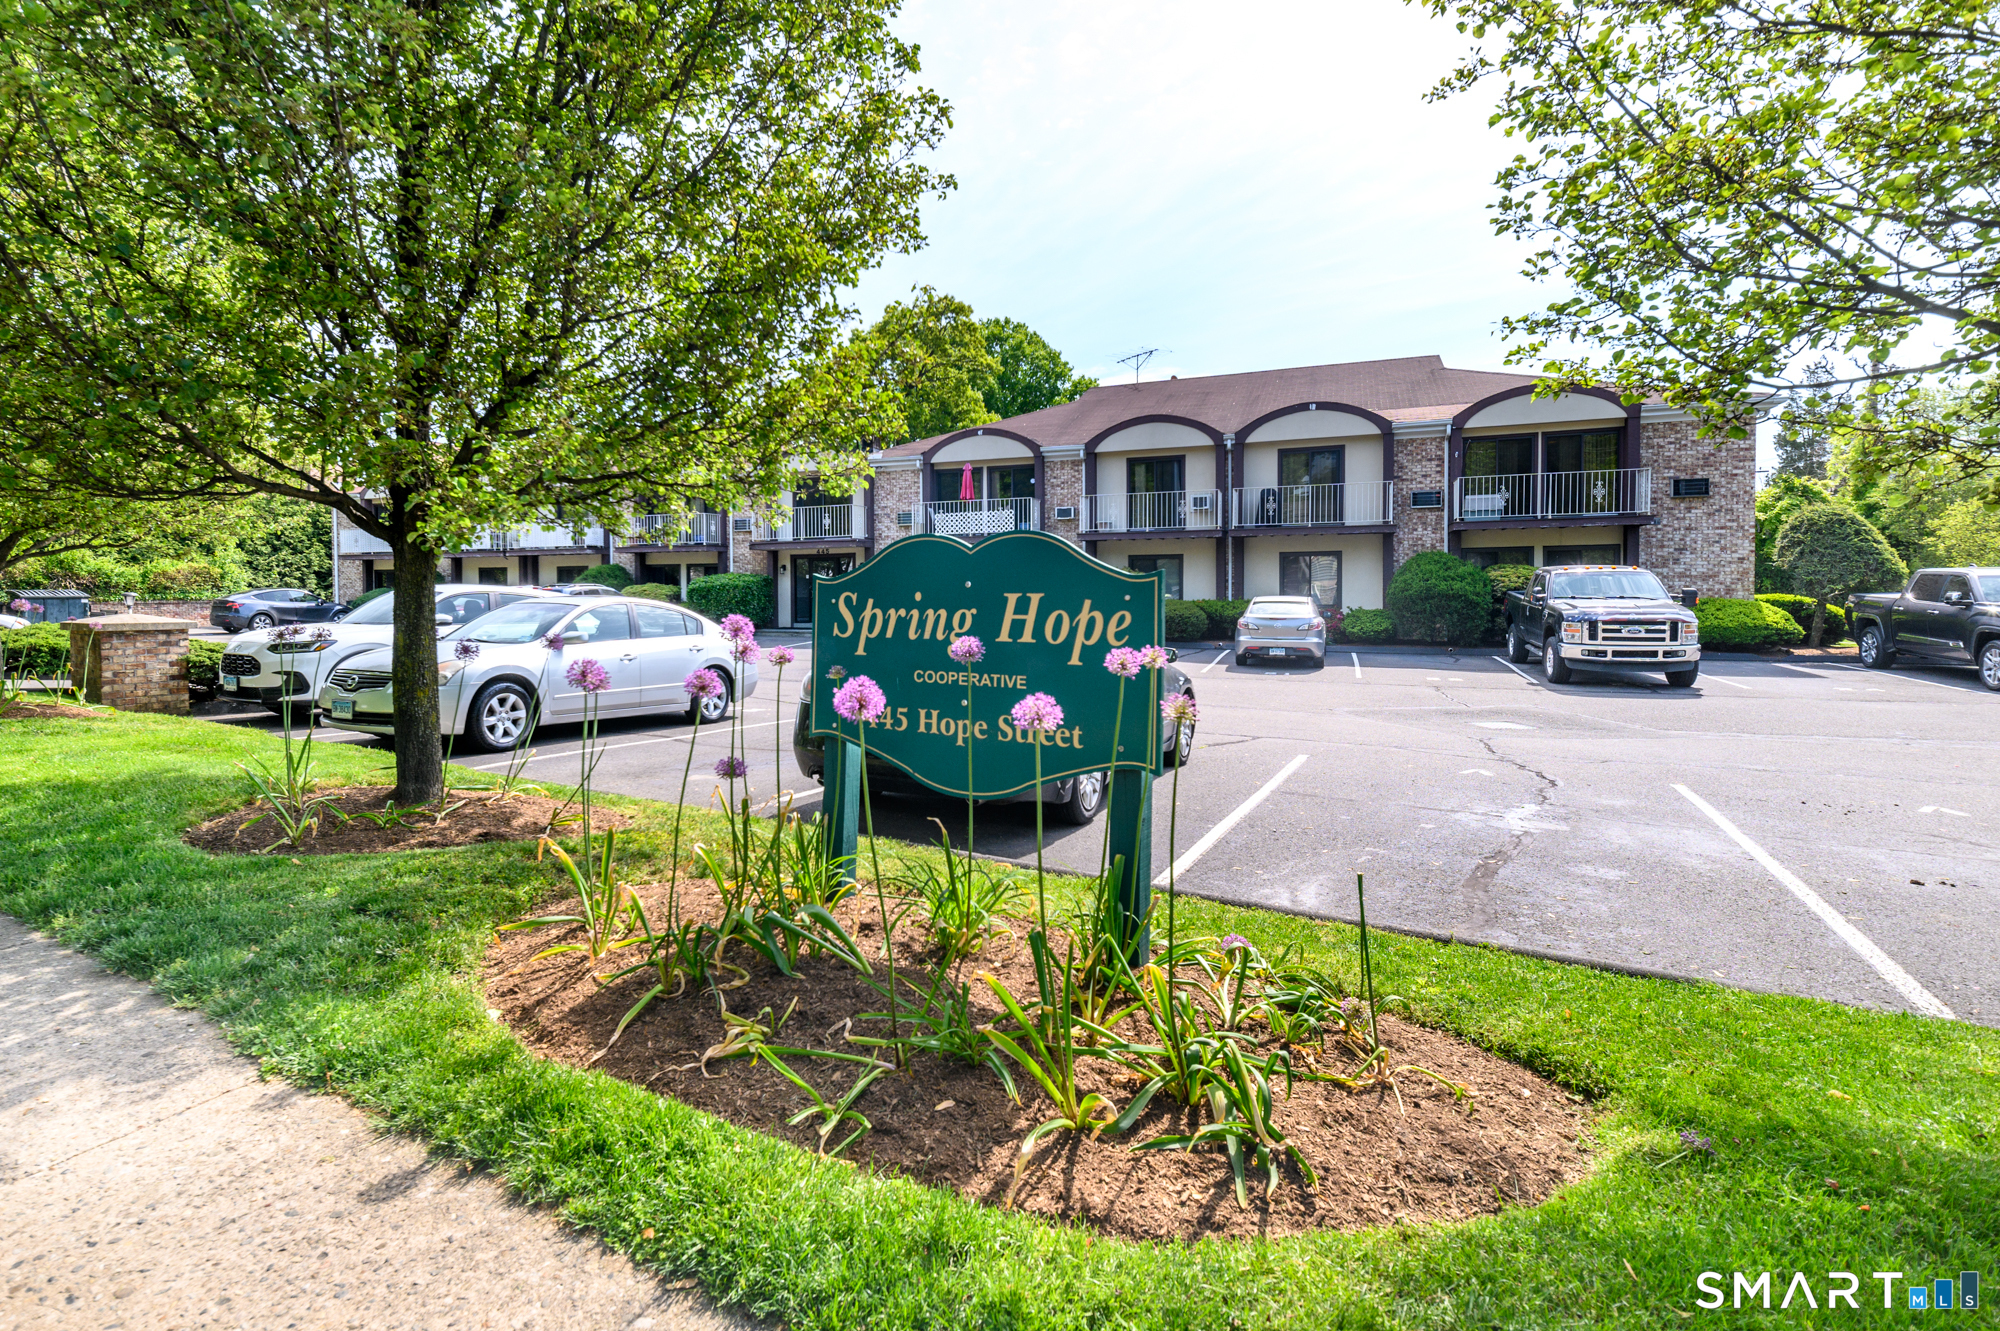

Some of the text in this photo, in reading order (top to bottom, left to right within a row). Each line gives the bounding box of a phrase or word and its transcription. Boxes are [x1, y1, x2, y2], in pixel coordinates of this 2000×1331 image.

[832, 591, 1132, 666] Spring Hope
[913, 669, 1027, 689] COOPERATIVE
[918, 708, 988, 746] Hope
